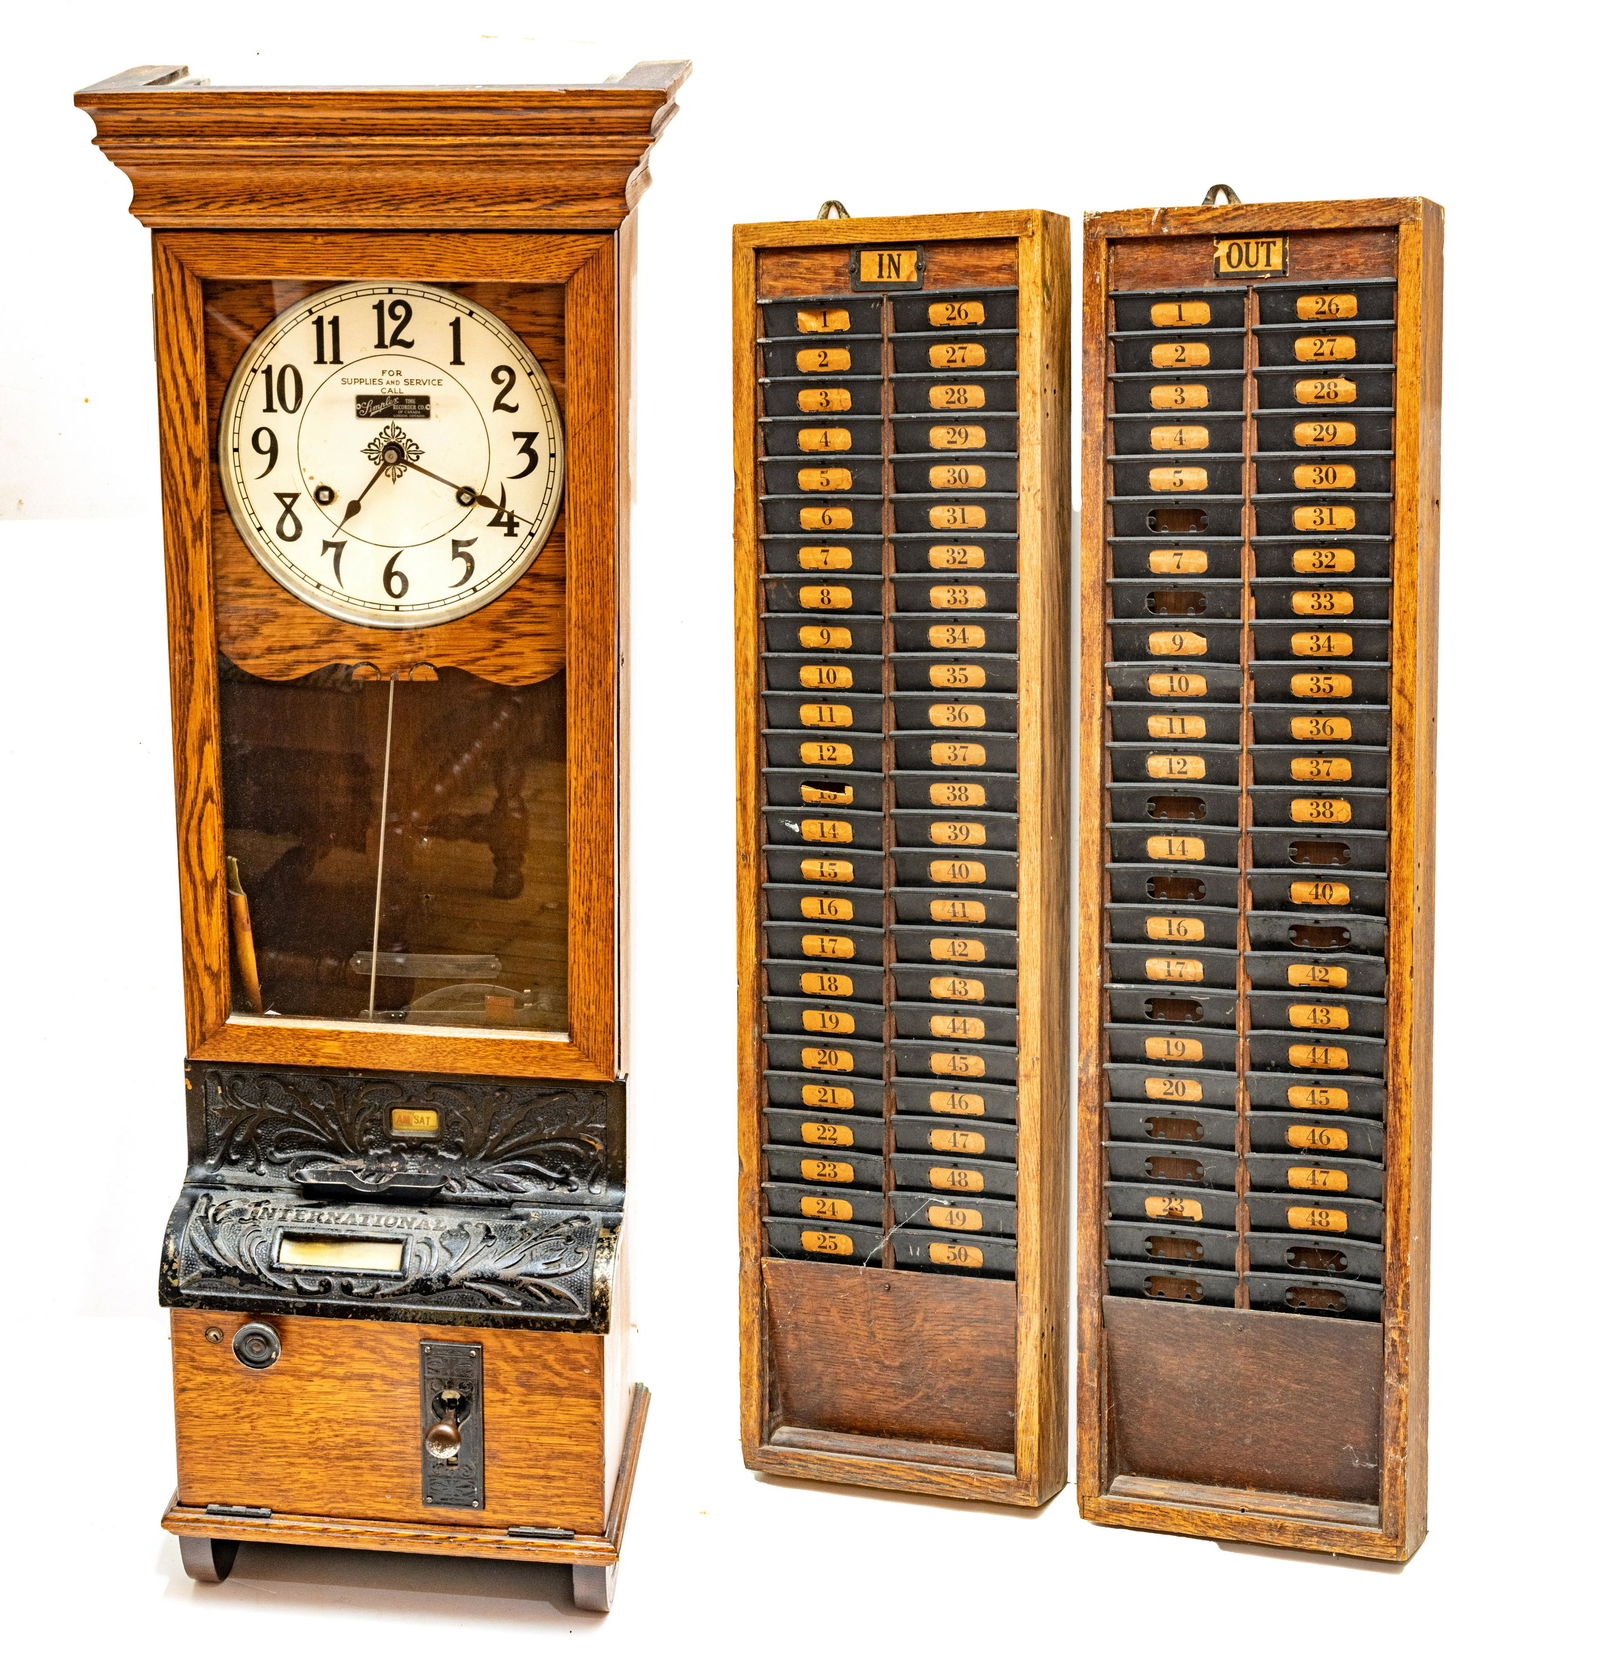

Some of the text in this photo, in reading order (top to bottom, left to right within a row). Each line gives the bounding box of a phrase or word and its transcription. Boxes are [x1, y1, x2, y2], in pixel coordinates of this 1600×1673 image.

[1226, 240, 1276, 268] OUT
[877, 254, 901, 278] IN
[945, 304, 968, 321] 26
[1176, 304, 1183, 321] 1
[1314, 296, 1340, 315] 26
[372, 299, 414, 350] 12
[821, 311, 827, 327] 1
[312, 315, 343, 365] 11
[449, 317, 465, 366] 1
[1313, 339, 1336, 356] 27
[817, 351, 828, 367] 2
[946, 346, 967, 363] 27
[1174, 346, 1186, 362] 2
[261, 364, 303, 414] 10
[491, 365, 519, 413] 2
[945, 388, 968, 404] 28
[1174, 387, 1185, 404] 3
[1314, 382, 1338, 400] 28
[359, 396, 399, 416] Simplex
[819, 391, 830, 408] 3
[819, 431, 831, 447] 4
[946, 428, 968, 444] 29
[1174, 429, 1186, 446] 4
[1312, 424, 1337, 442] 29
[252, 426, 279, 480] 9
[507, 432, 540, 480] 3
[820, 471, 830, 486] 5
[947, 468, 969, 484] 30
[1173, 470, 1184, 486] 5
[1312, 467, 1336, 484] 30
[273, 492, 303, 542] 8
[487, 481, 519, 537] 4
[821, 509, 832, 525] 6
[947, 508, 968, 524] 31
[1312, 508, 1336, 526] 31
[321, 539, 348, 589] 7
[449, 537, 478, 588] 5
[821, 549, 830, 565] 7
[946, 548, 967, 564] 32
[1173, 552, 1183, 570] 7
[1312, 551, 1336, 569] 32
[383, 550, 408, 599] 6
[820, 589, 831, 605] 8
[947, 588, 968, 604] 33
[1311, 593, 1334, 610] 33
[820, 629, 831, 645] 9
[946, 628, 969, 644] 34
[1172, 634, 1184, 652] 9
[1310, 636, 1334, 652] 34
[817, 668, 837, 684] 10
[947, 668, 968, 684] 35
[1168, 676, 1190, 692] 10
[1310, 676, 1334, 694] 35
[817, 706, 836, 722] 11
[946, 707, 968, 723] 36
[1167, 718, 1188, 734] 11
[1310, 719, 1334, 736] 36
[817, 745, 837, 761] 12
[948, 745, 967, 761] 37
[1166, 758, 1188, 775] 12
[1310, 760, 1333, 777] 37
[947, 785, 968, 801] 38
[1310, 802, 1334, 819] 38
[817, 823, 838, 838] 14
[948, 825, 970, 841] 39
[1166, 839, 1188, 856] 14
[817, 862, 837, 877] 15
[947, 863, 969, 880] 40
[1309, 884, 1333, 900] 40
[817, 900, 838, 915] 16
[947, 902, 967, 918] 41
[1166, 920, 1188, 936] 16
[818, 938, 837, 954] 17
[947, 941, 968, 957] 42
[1165, 961, 1186, 978] 17
[1306, 967, 1330, 983] 42
[817, 976, 838, 992] 18
[947, 980, 968, 996] 43
[819, 1013, 839, 1029] 19
[1307, 1008, 1331, 1024] 43
[947, 1018, 968, 1034] 44
[1165, 1040, 1186, 1057] 19
[1306, 1047, 1332, 1064] 44
[817, 1049, 838, 1065] 20
[947, 1056, 968, 1072] 45
[817, 1088, 837, 1104] 21
[1162, 1080, 1186, 1098] 20
[1306, 1088, 1330, 1106] 45
[947, 1094, 968, 1110] 46
[413, 1115, 430, 1125] SAT
[817, 1125, 837, 1141] 22
[948, 1132, 969, 1148] 47
[1306, 1128, 1330, 1146] 46
[817, 1162, 837, 1178] 23
[947, 1170, 968, 1187] 48
[1306, 1170, 1330, 1187] 47
[239, 1199, 447, 1231] INTERNATIONAL
[817, 1199, 838, 1215] 24
[945, 1209, 966, 1226] 49
[1306, 1210, 1330, 1227] 48
[817, 1234, 838, 1250] 25
[947, 1246, 967, 1262] 50
